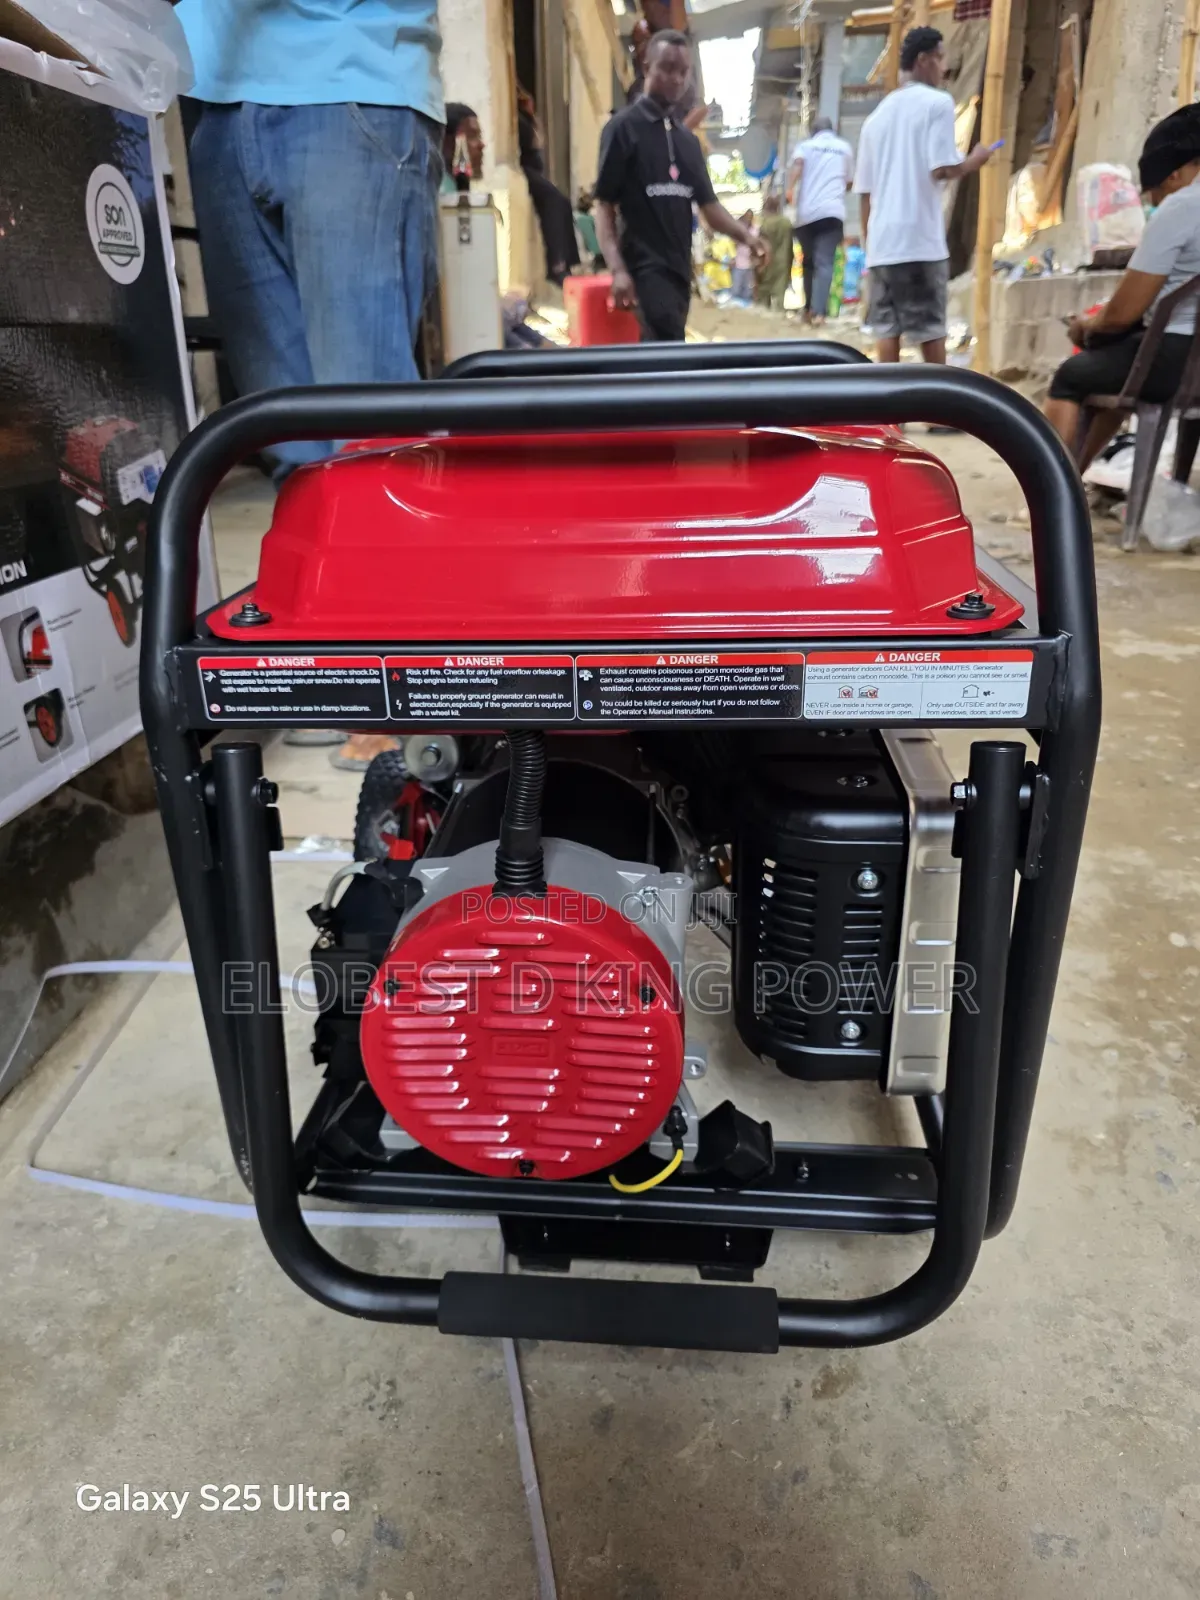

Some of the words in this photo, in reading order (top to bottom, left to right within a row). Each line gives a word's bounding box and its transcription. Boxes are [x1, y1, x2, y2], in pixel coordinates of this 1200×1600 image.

[103, 228, 132, 241] APPROVED
[457, 656, 504, 667] DANGER
[669, 655, 719, 665] DANGER
[888, 652, 941, 662] DANGER
[268, 657, 315, 667] DANGER
[430, 668, 443, 676] fire.
[476, 669, 489, 677] any
[600, 667, 627, 675] Exhaust
[629, 667, 656, 675] contains
[658, 667, 693, 675] poisonous
[719, 666, 754, 674] monoxide
[769, 665, 783, 673] that
[831, 666, 860, 674] generator
[407, 677, 423, 686] Stop
[423, 677, 446, 686] engine
[469, 677, 499, 686] refueling
[733, 675, 762, 683] Operate
[682, 685, 702, 693] away
[778, 683, 800, 691] doors.
[440, 693, 467, 701] properly
[467, 693, 491, 701] ground
[492, 693, 523, 701] generator
[501, 701, 533, 710] generator
[541, 701, 572, 709] equipped
[671, 699, 701, 707] seriously
[722, 699, 736, 707] you
[759, 698, 781, 706] follow
[926, 701, 942, 709] Only
[612, 708, 647, 716] Operator's
[941, 709, 969, 717] windows,
